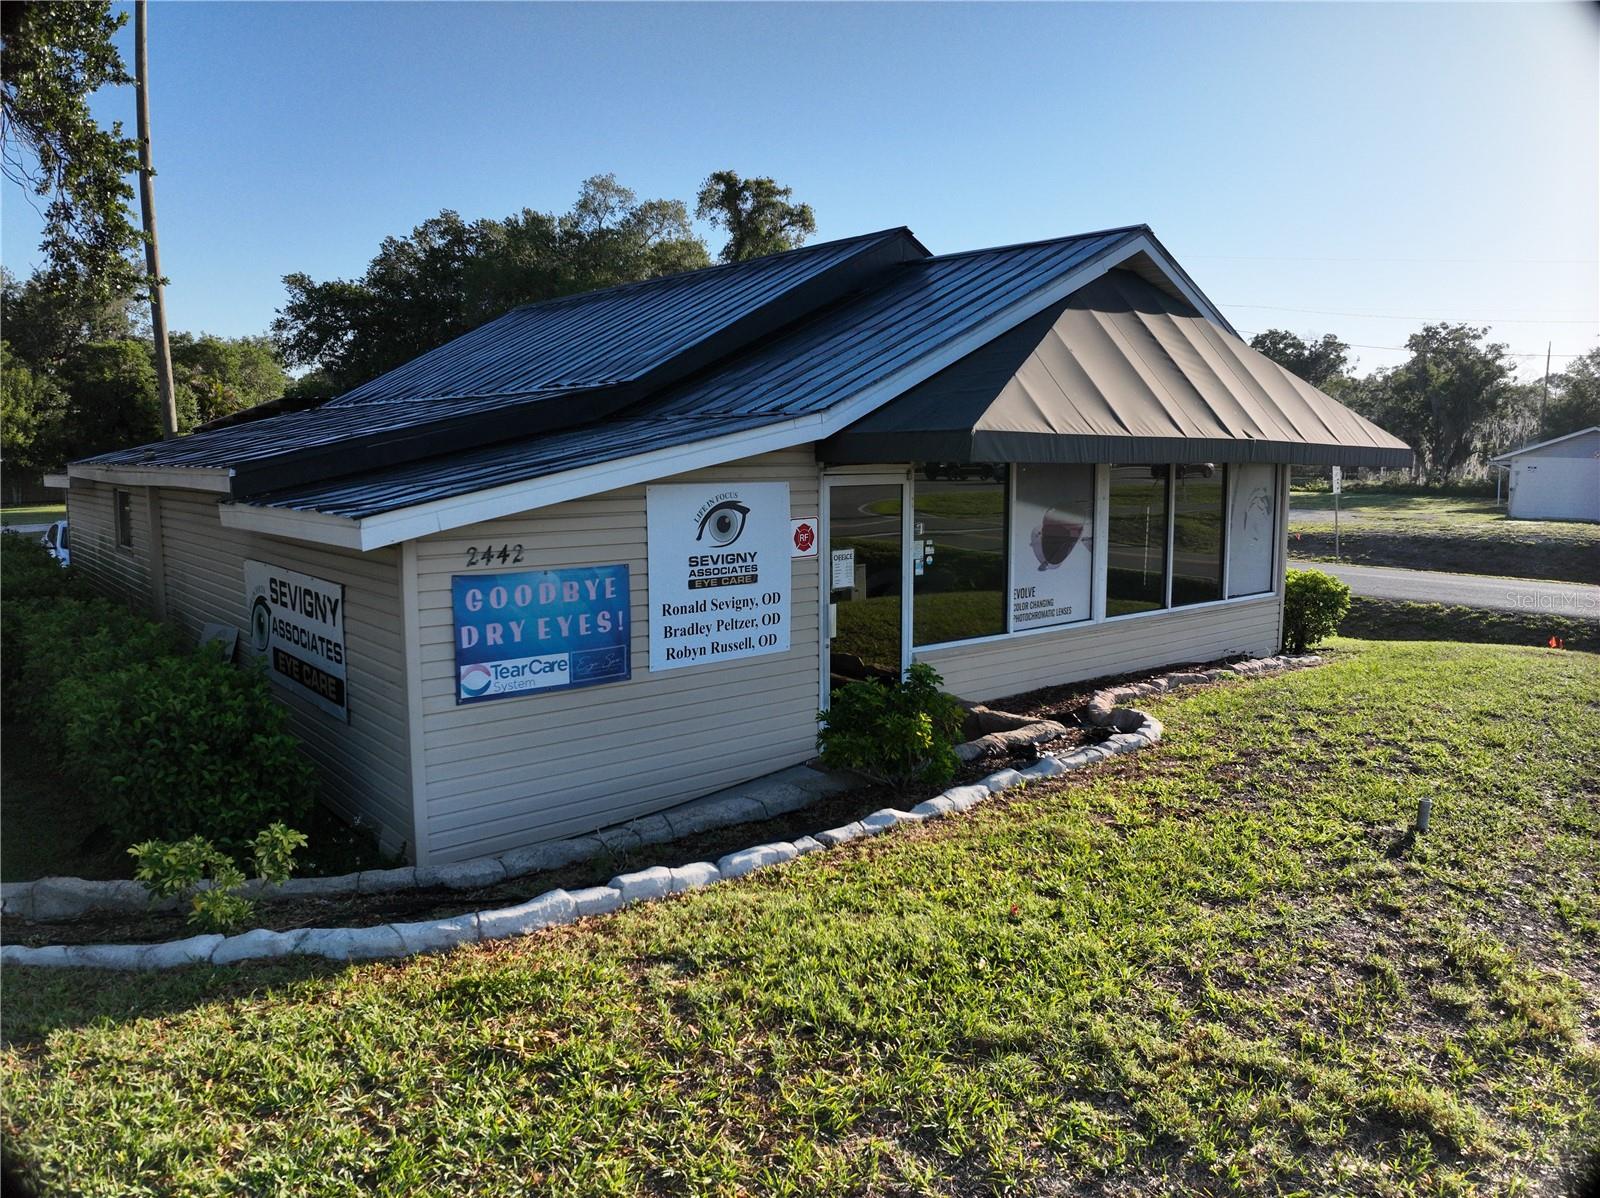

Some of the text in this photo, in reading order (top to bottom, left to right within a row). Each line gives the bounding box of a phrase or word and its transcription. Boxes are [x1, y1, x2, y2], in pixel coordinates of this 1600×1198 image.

[693, 491, 739, 524] LIFE IN FOCUS
[800, 533, 809, 542] RF
[466, 544, 525, 567] 2442
[688, 552, 758, 567] SEVIGNY
[688, 564, 758, 578] ASSOCIATES
[695, 575, 753, 588] EYE CARE
[269, 576, 340, 628] SEVIGNY
[465, 577, 617, 612] GOODBYE
[662, 592, 782, 617] Ronald Sevigny, OD
[460, 610, 624, 649] DRY EYES!
[663, 612, 781, 639] Bradley Peltzer, OD
[272, 616, 343, 665] ASSOCIATES
[666, 633, 778, 661] Robyn Russell, OD
[277, 651, 337, 700] EYE CARE
[493, 678, 536, 693] System
